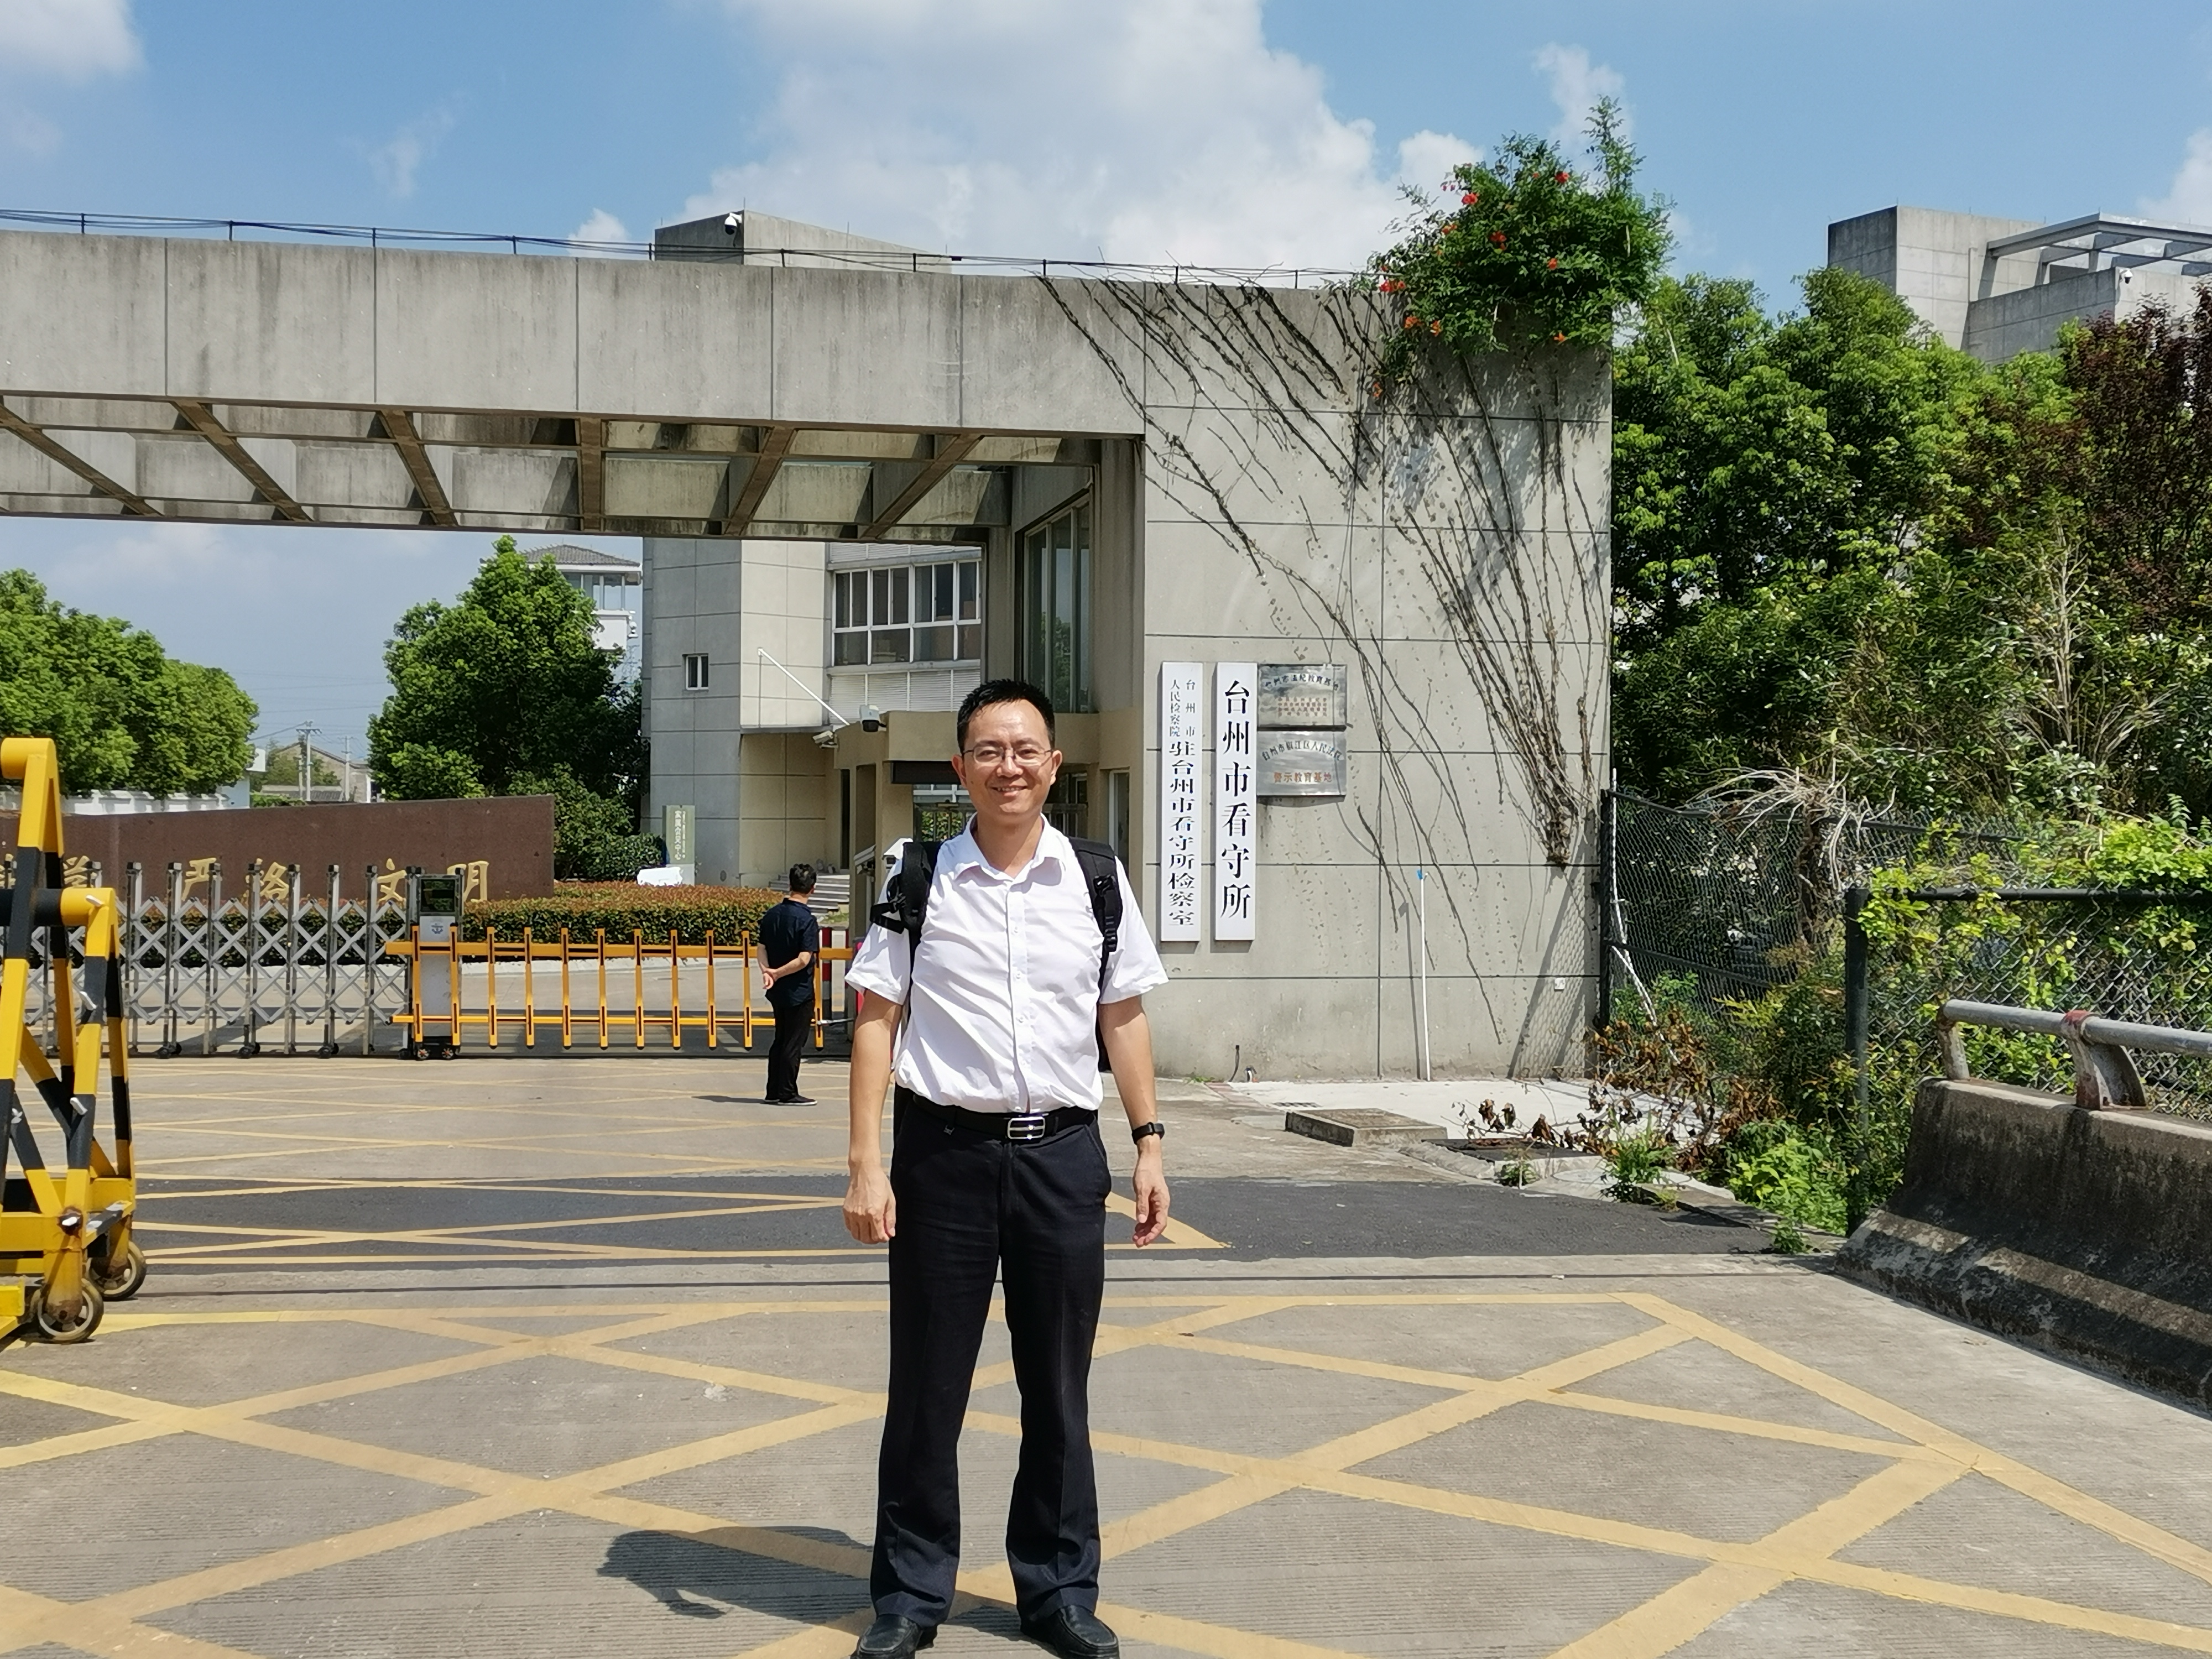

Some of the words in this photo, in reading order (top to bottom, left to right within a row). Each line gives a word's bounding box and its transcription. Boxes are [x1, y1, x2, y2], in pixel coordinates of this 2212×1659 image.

[1170, 679, 1181, 737] 人民检察院
[1186, 679, 1196, 737] 台州市
[1221, 680, 1251, 919] 台州市看守所
[1274, 771, 1332, 783] 警示教育基地
[1167, 741, 1196, 926] 驻台州市看守所检察室
[376, 858, 489, 902] 文明
